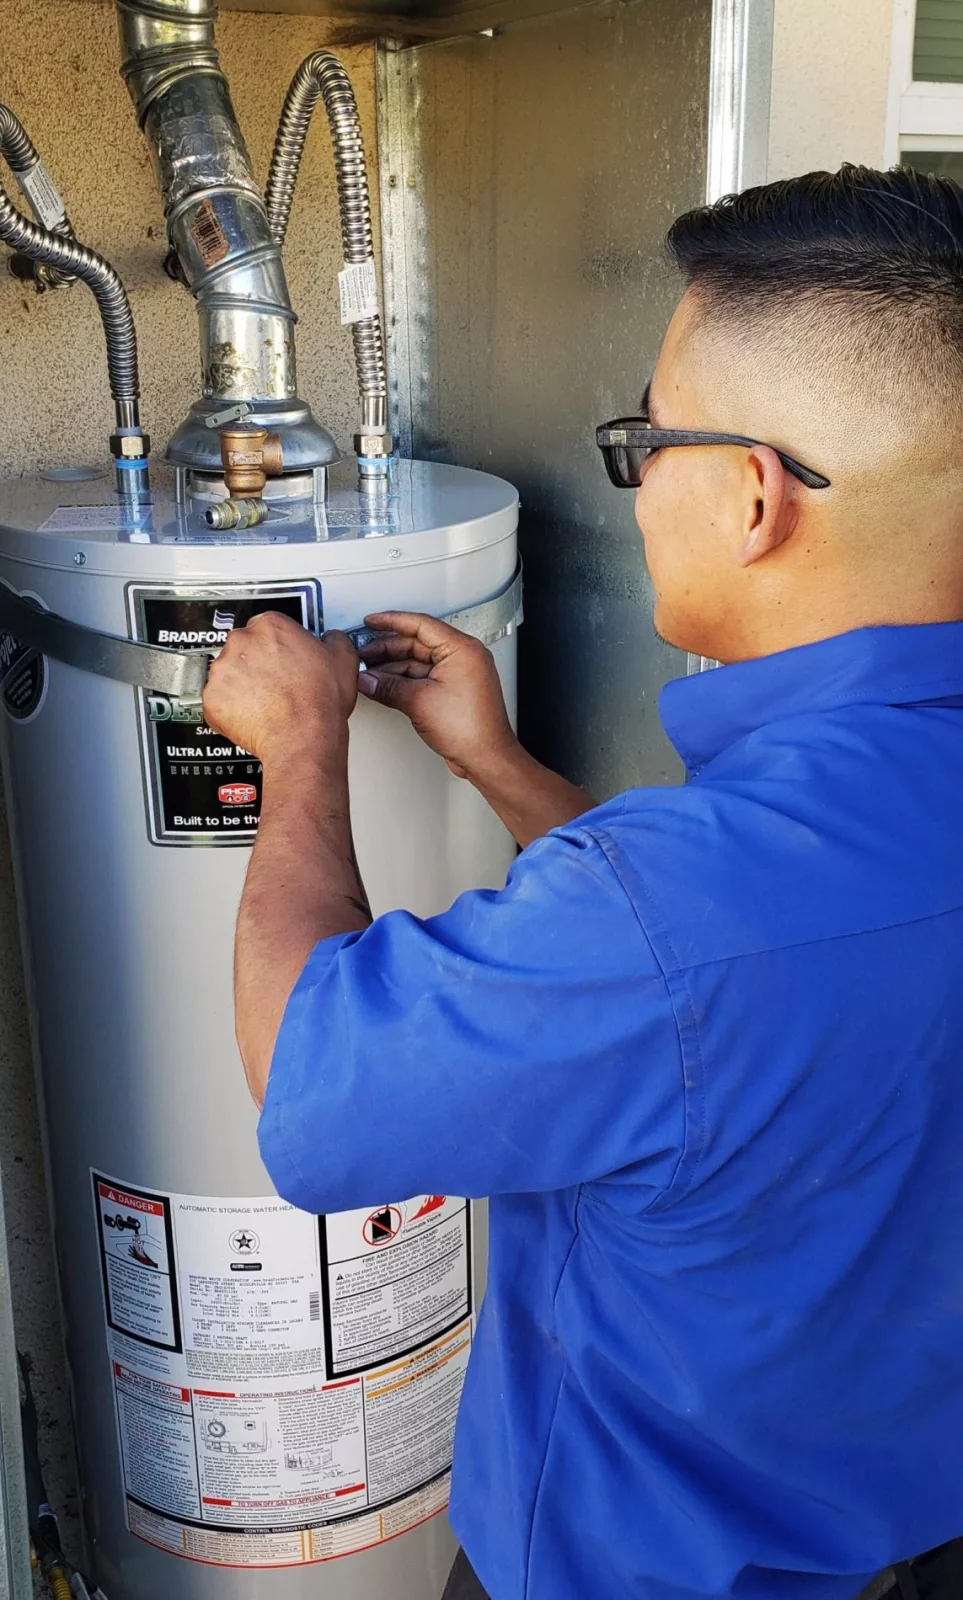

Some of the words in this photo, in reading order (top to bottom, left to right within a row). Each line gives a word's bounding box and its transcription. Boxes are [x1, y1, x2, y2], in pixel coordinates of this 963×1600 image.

[158, 630, 227, 642] BRADFOR
[196, 726, 218, 735] SAF
[167, 746, 203, 756] ULTRA
[206, 746, 232, 756] LOW
[170, 766, 234, 775] ENERGY
[174, 816, 202, 826] Built
[205, 816, 220, 826] to
[223, 816, 240, 825] be
[118, 1194, 154, 1212] DANGER
[179, 1204, 218, 1213] AUTOMATIC
[403, 1221, 426, 1234] Flammable
[362, 1256, 375, 1264] FIRE
[389, 1240, 418, 1255] EXPLOSION
[419, 1229, 438, 1242] HAZARD
[298, 1494, 329, 1504] APPLIANCE
[272, 1524, 306, 1533] DIAGNOSTIC
